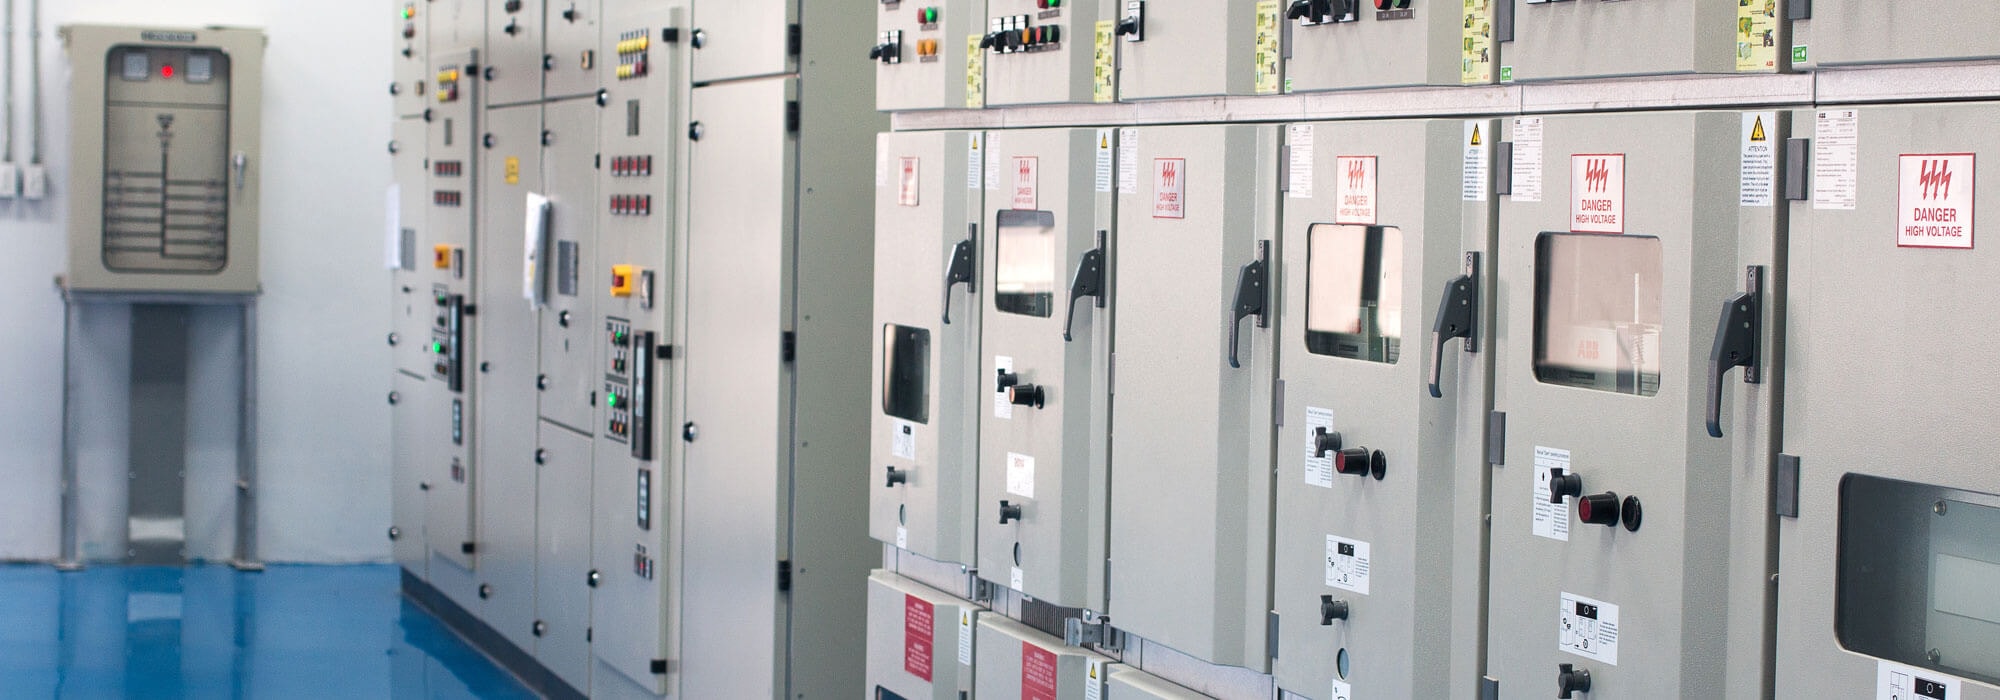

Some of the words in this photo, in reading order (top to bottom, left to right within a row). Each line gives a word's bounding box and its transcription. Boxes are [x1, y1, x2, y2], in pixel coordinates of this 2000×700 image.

[1160, 192, 1178, 202] DANGER
[1344, 195, 1368, 206] DANGER
[1581, 199, 1612, 212] DANGER
[1575, 214, 1590, 224] HIGH
[1590, 214, 1616, 224] VOLTAGE
[1914, 207, 1957, 222] DANGER
[1905, 225, 1924, 237] HIGH
[1926, 226, 1963, 237] VOLTAGE
[1577, 340, 1600, 360] ABB
